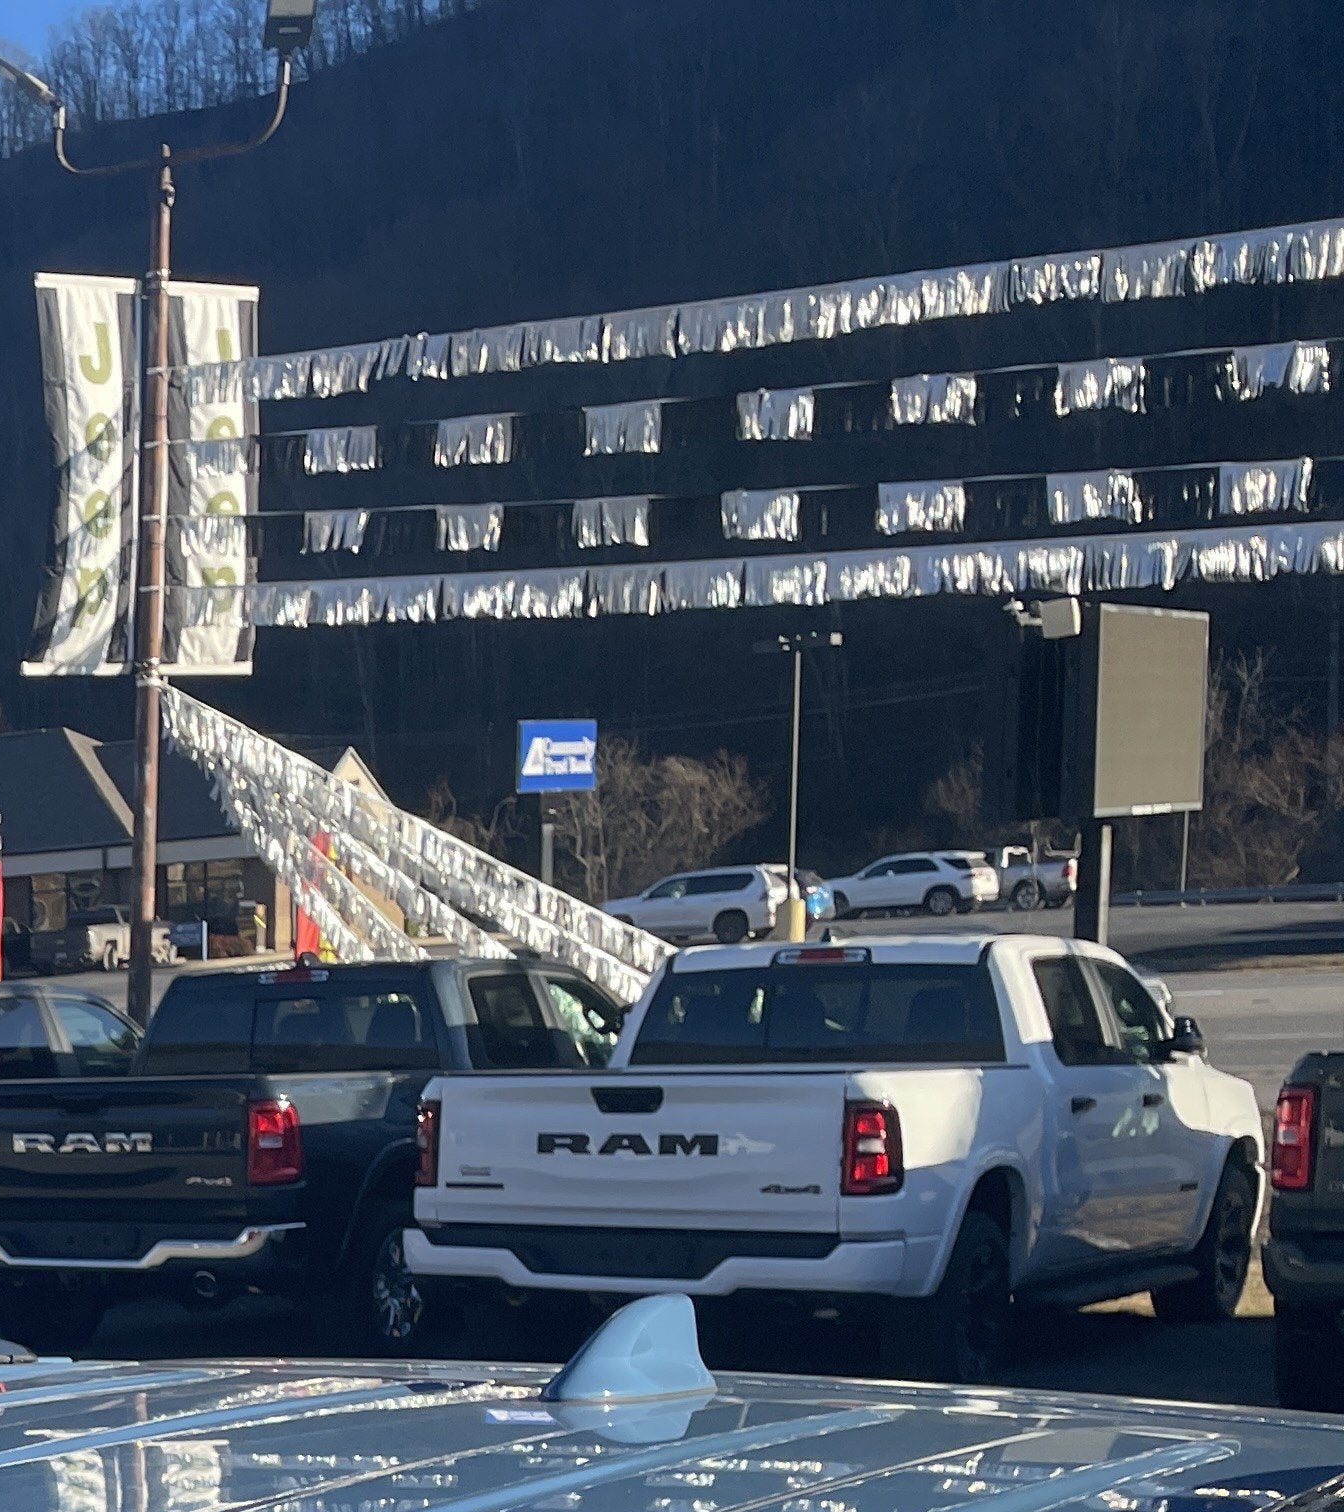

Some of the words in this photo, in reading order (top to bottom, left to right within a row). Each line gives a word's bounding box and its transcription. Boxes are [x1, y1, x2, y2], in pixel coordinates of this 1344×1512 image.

[77, 322, 116, 629] Jeep
[12, 1132, 155, 1153] RAM
[537, 1133, 719, 1155] RAM
